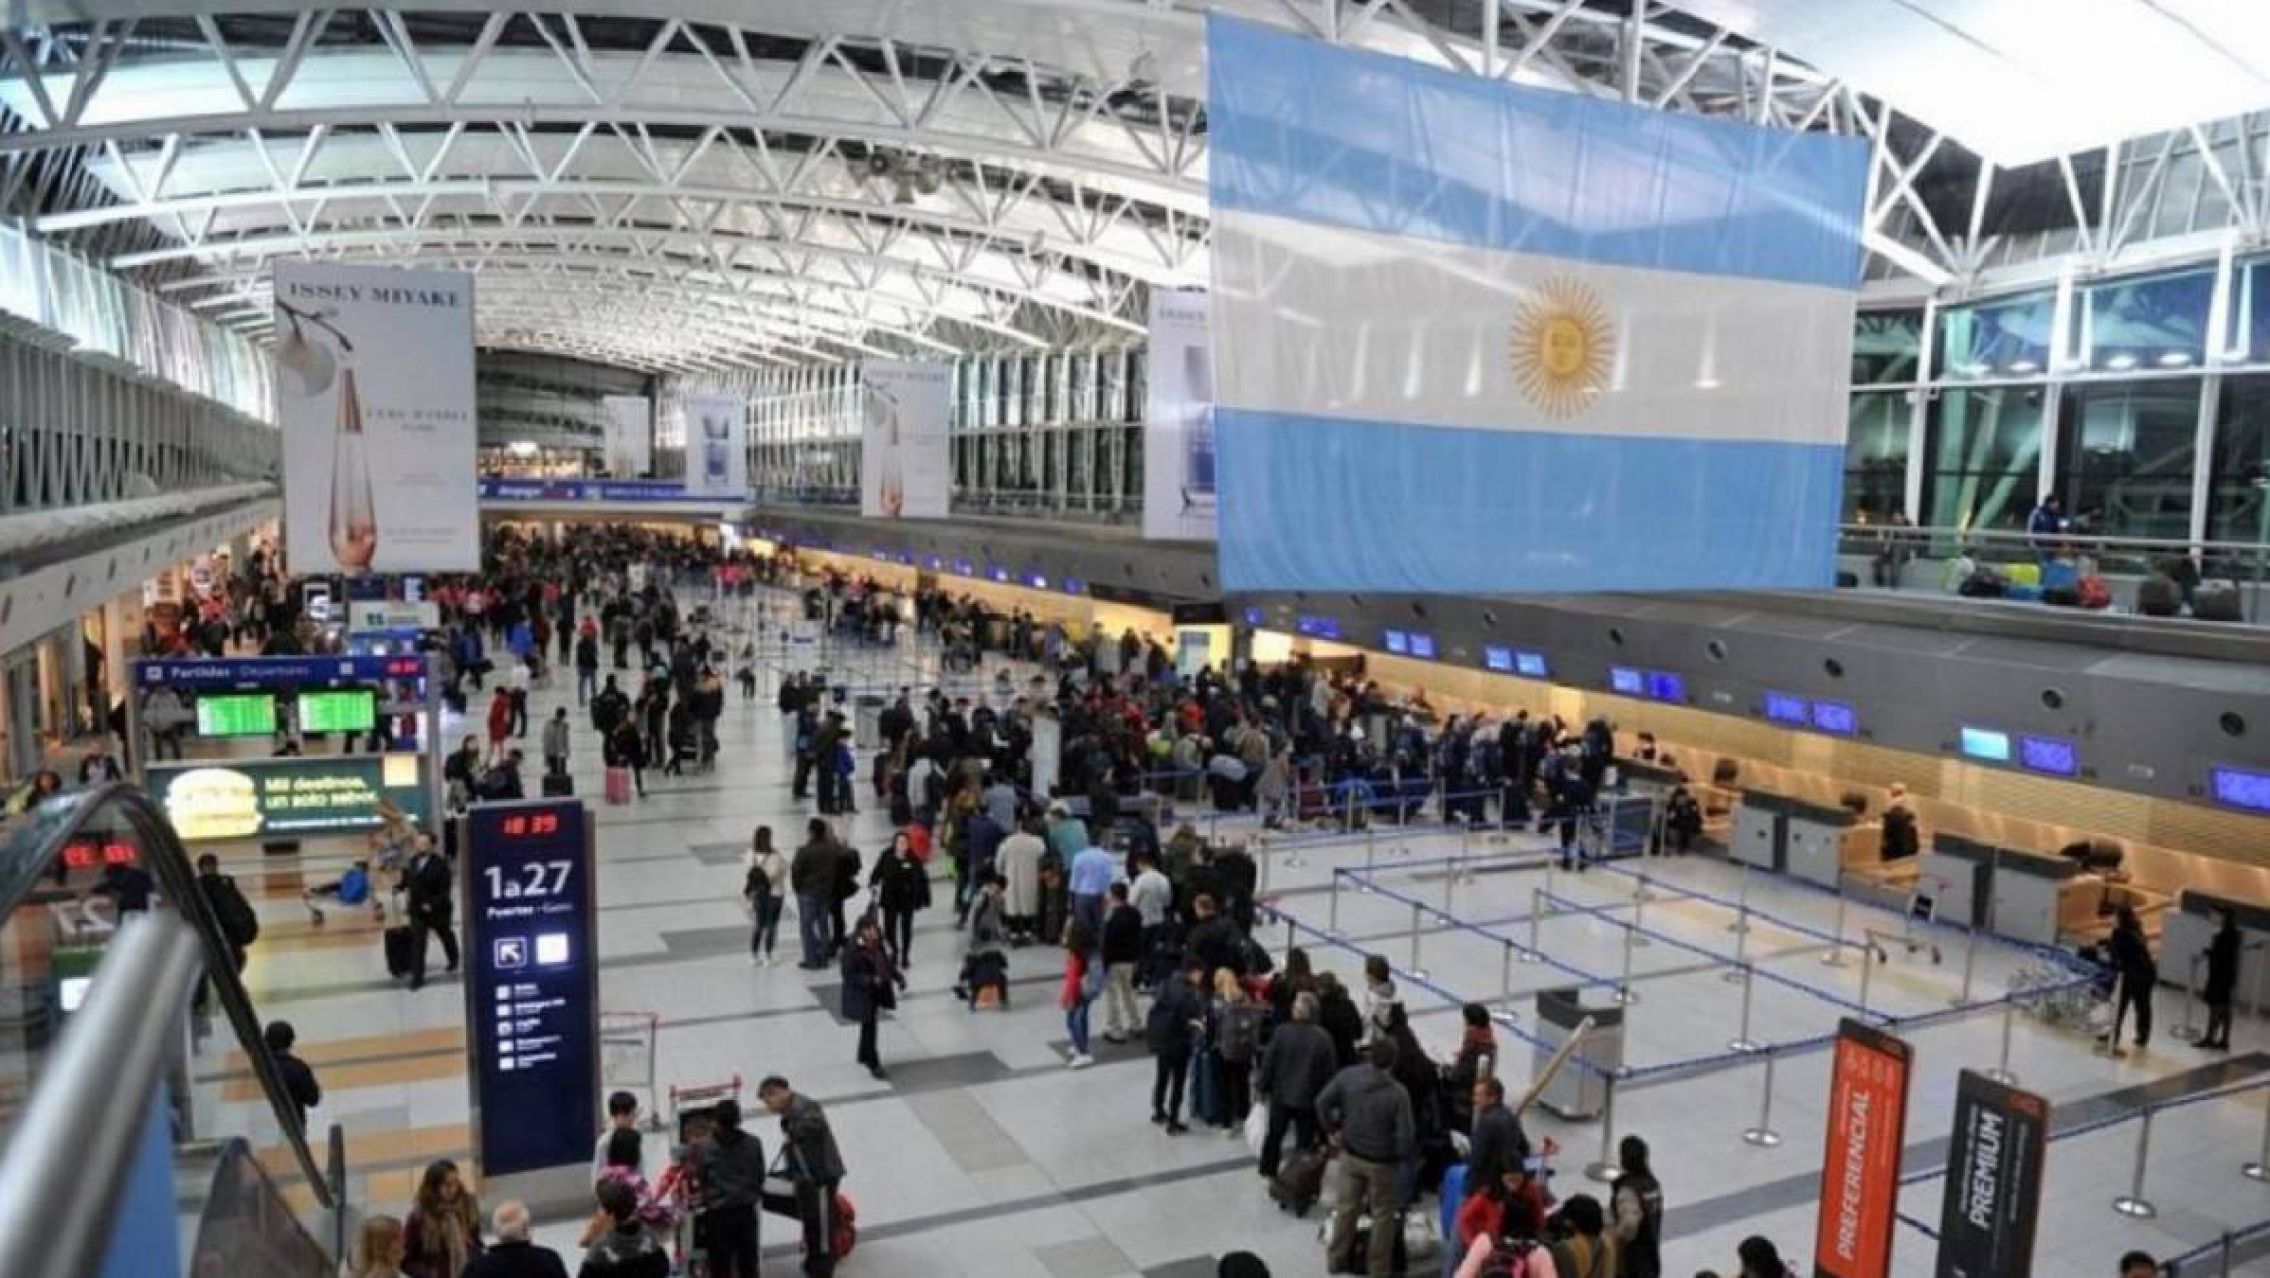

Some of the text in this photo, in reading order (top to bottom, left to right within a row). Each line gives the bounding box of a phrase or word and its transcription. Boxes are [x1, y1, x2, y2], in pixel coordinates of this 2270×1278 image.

[371, 287, 458, 307] MIYAKE
[1837, 1090, 1870, 1259] PREFERENCIAL
[1968, 1110, 2003, 1230] PREMIUM
